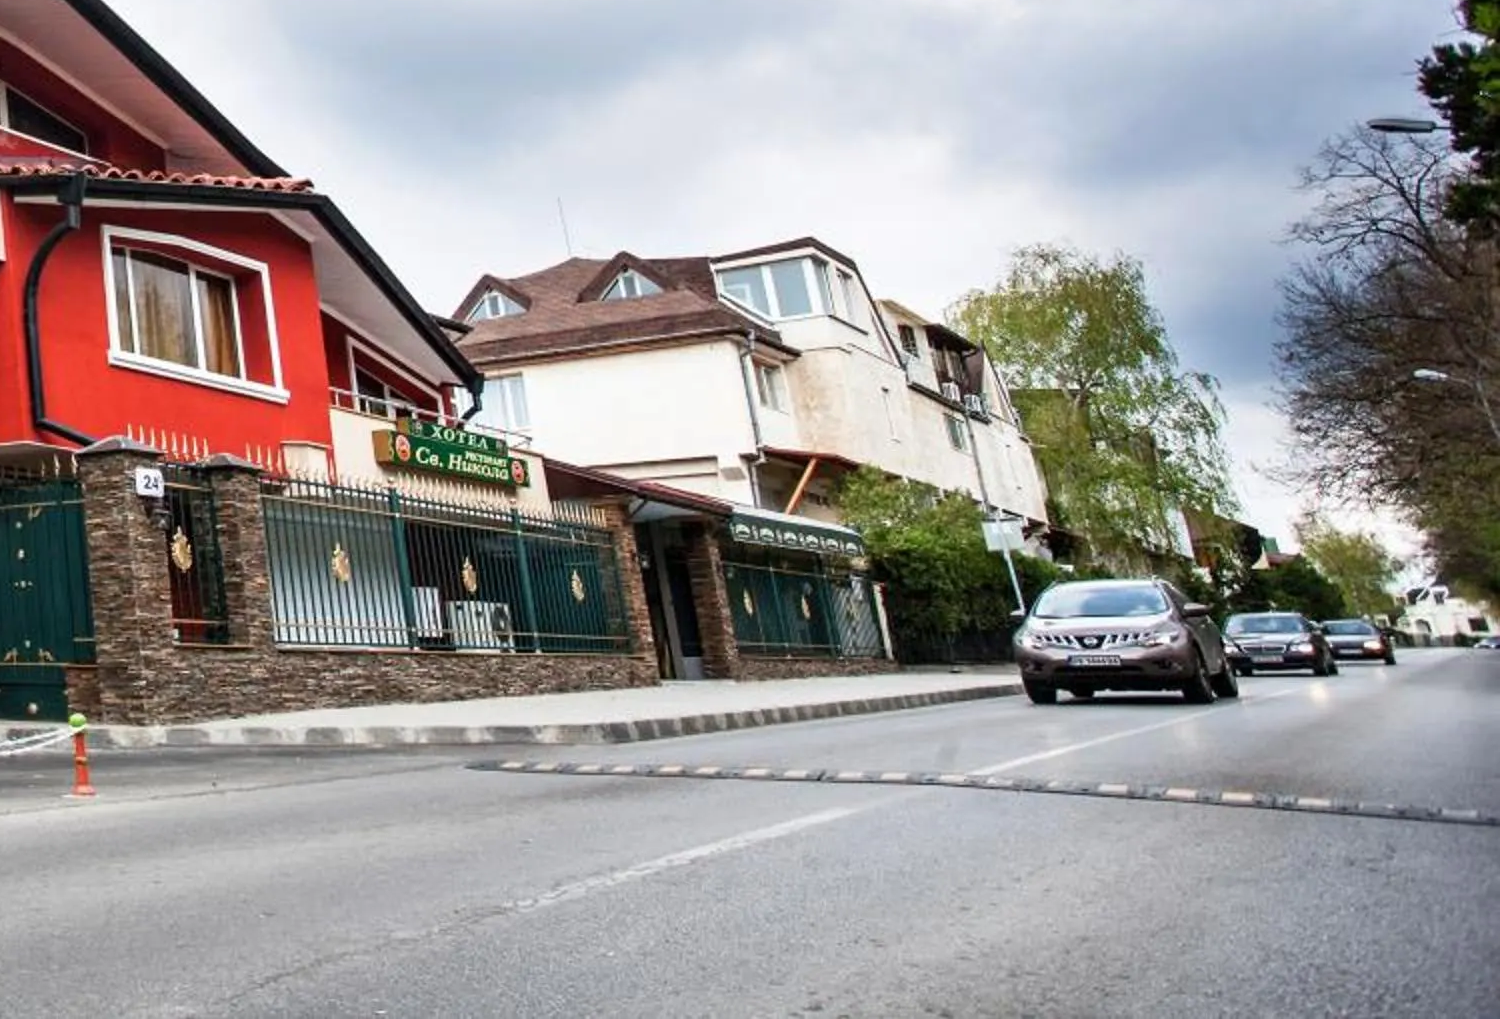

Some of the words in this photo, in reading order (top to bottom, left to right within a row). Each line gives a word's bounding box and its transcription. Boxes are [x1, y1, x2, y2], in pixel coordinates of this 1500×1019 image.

[431, 425, 488, 450] ХОТЕЛ
[416, 446, 443, 468] Св.
[447, 453, 510, 480] Никола
[143, 474, 159, 491] 24
